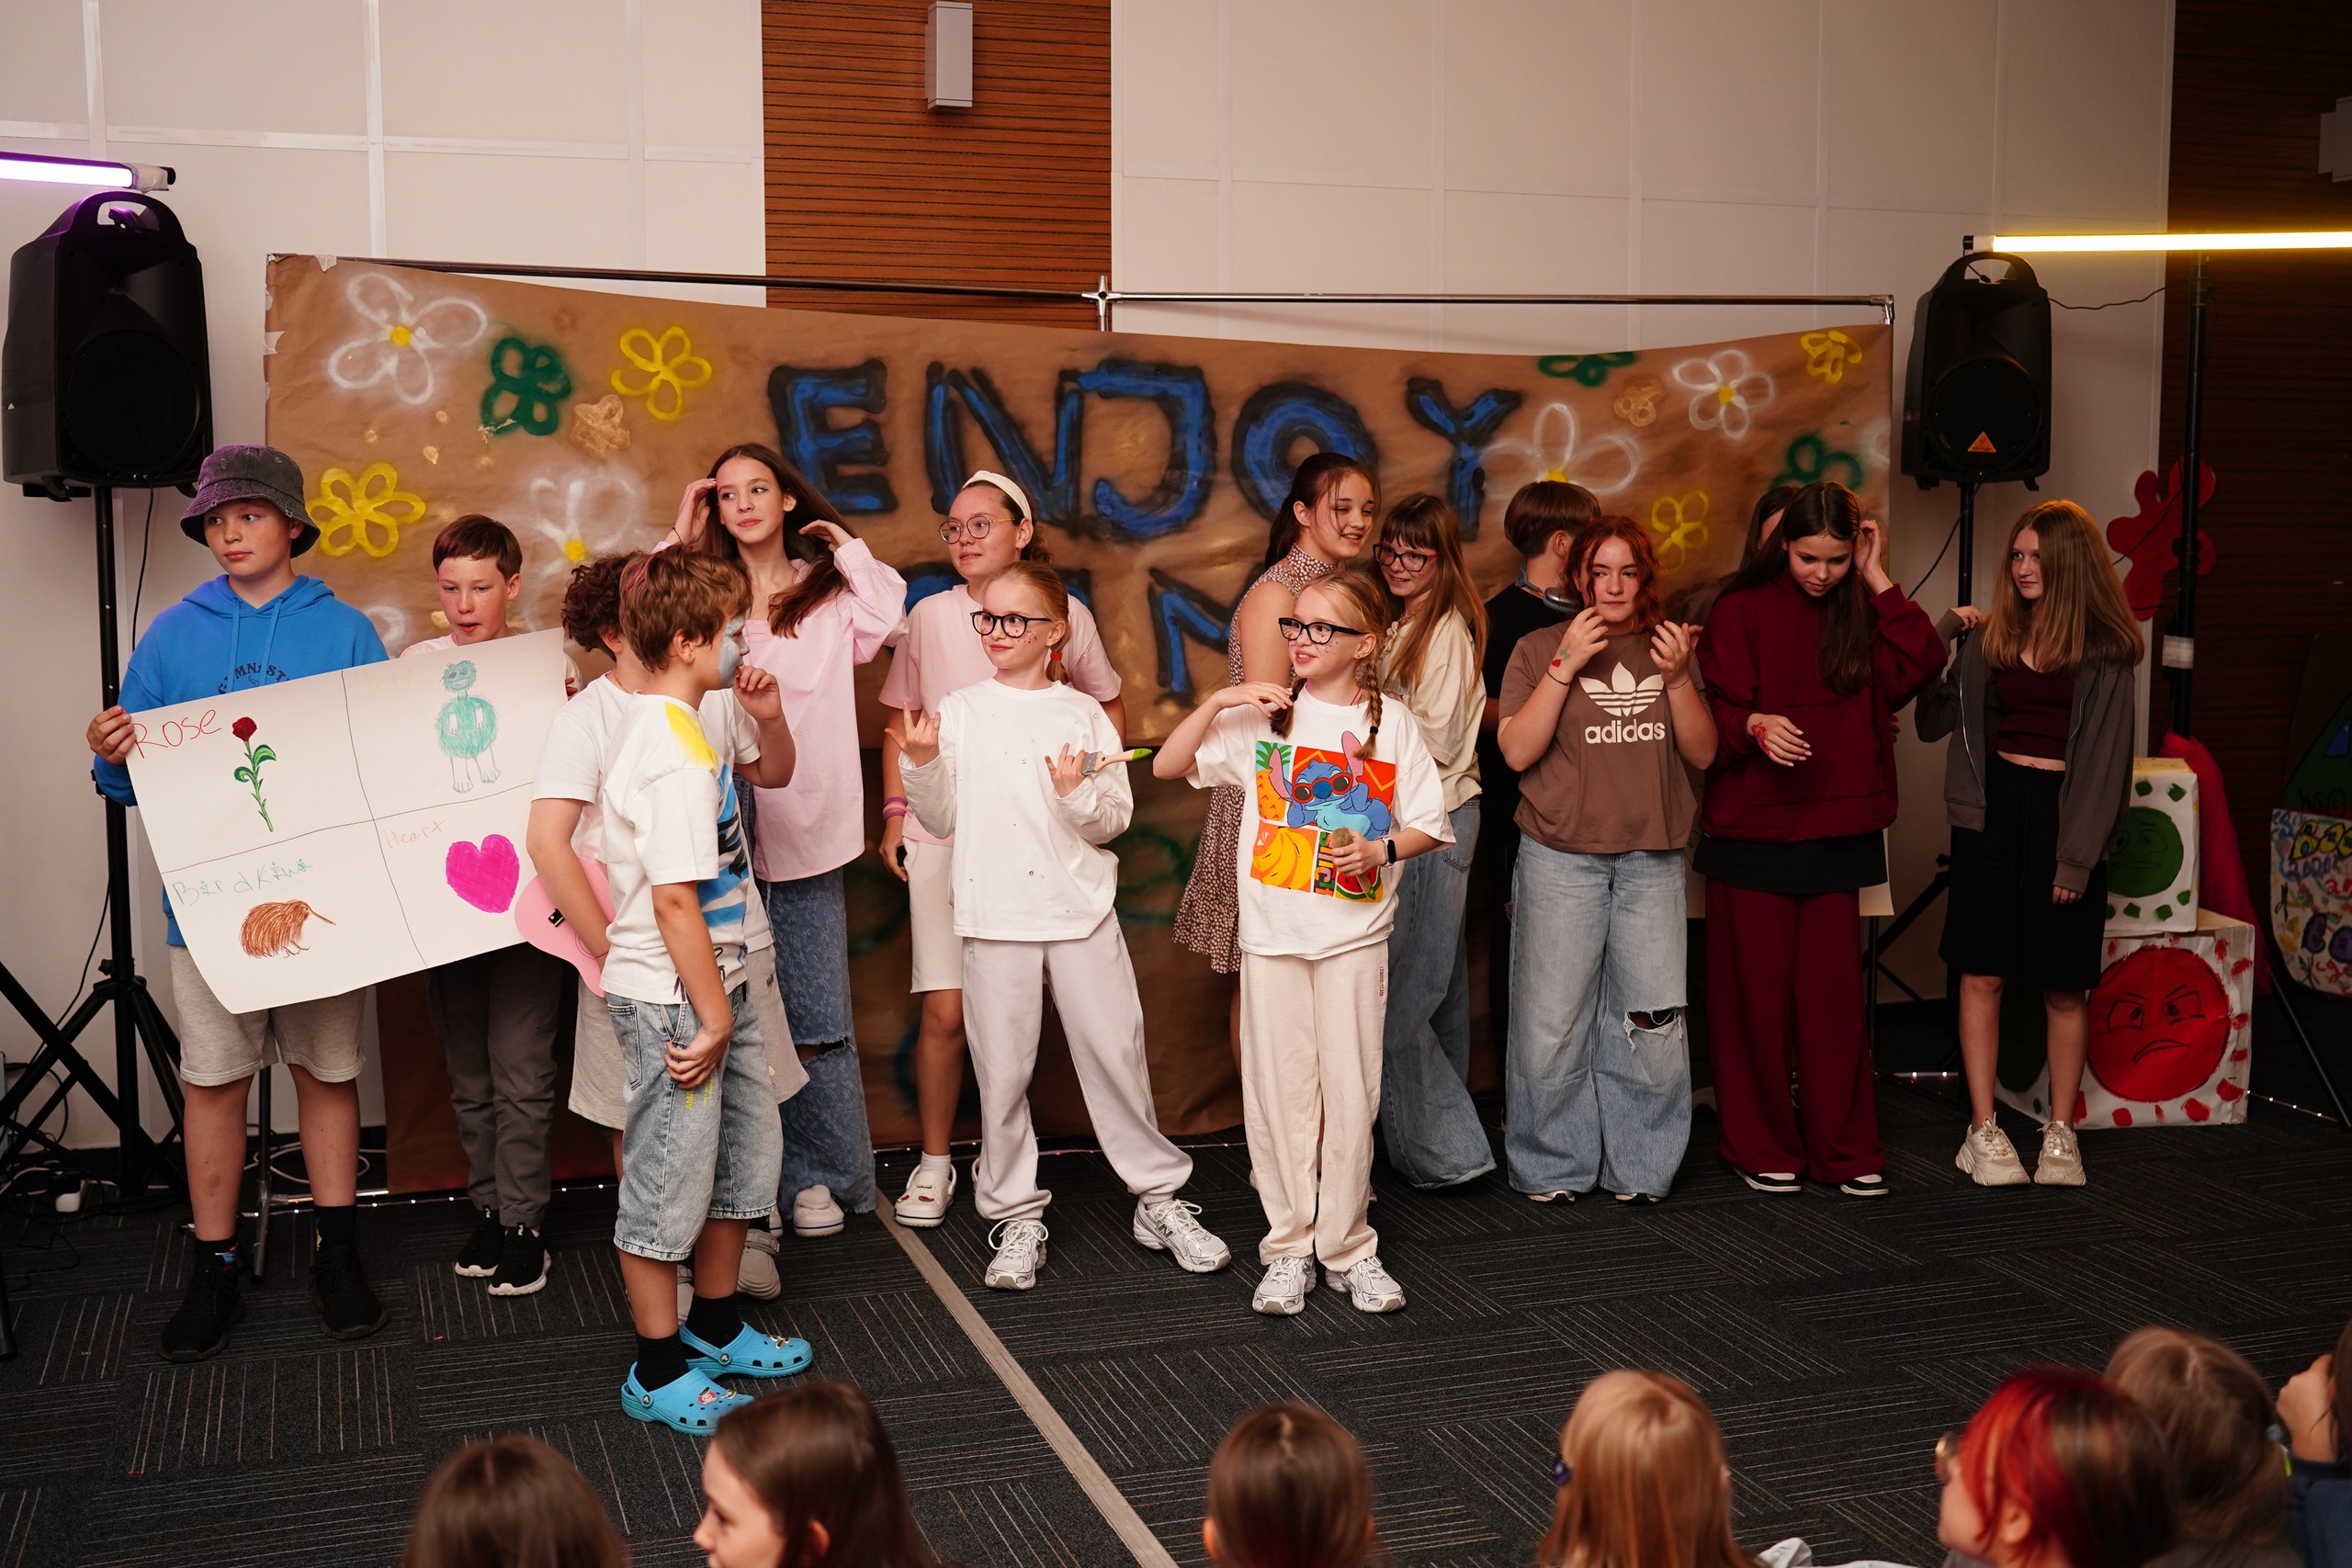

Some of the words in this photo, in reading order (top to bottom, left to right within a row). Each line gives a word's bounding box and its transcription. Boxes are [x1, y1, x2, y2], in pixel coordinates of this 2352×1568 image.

[767, 358, 1523, 544] ENJOY
[1585, 718, 1666, 744] adidas
[382, 820, 446, 850] Heart
